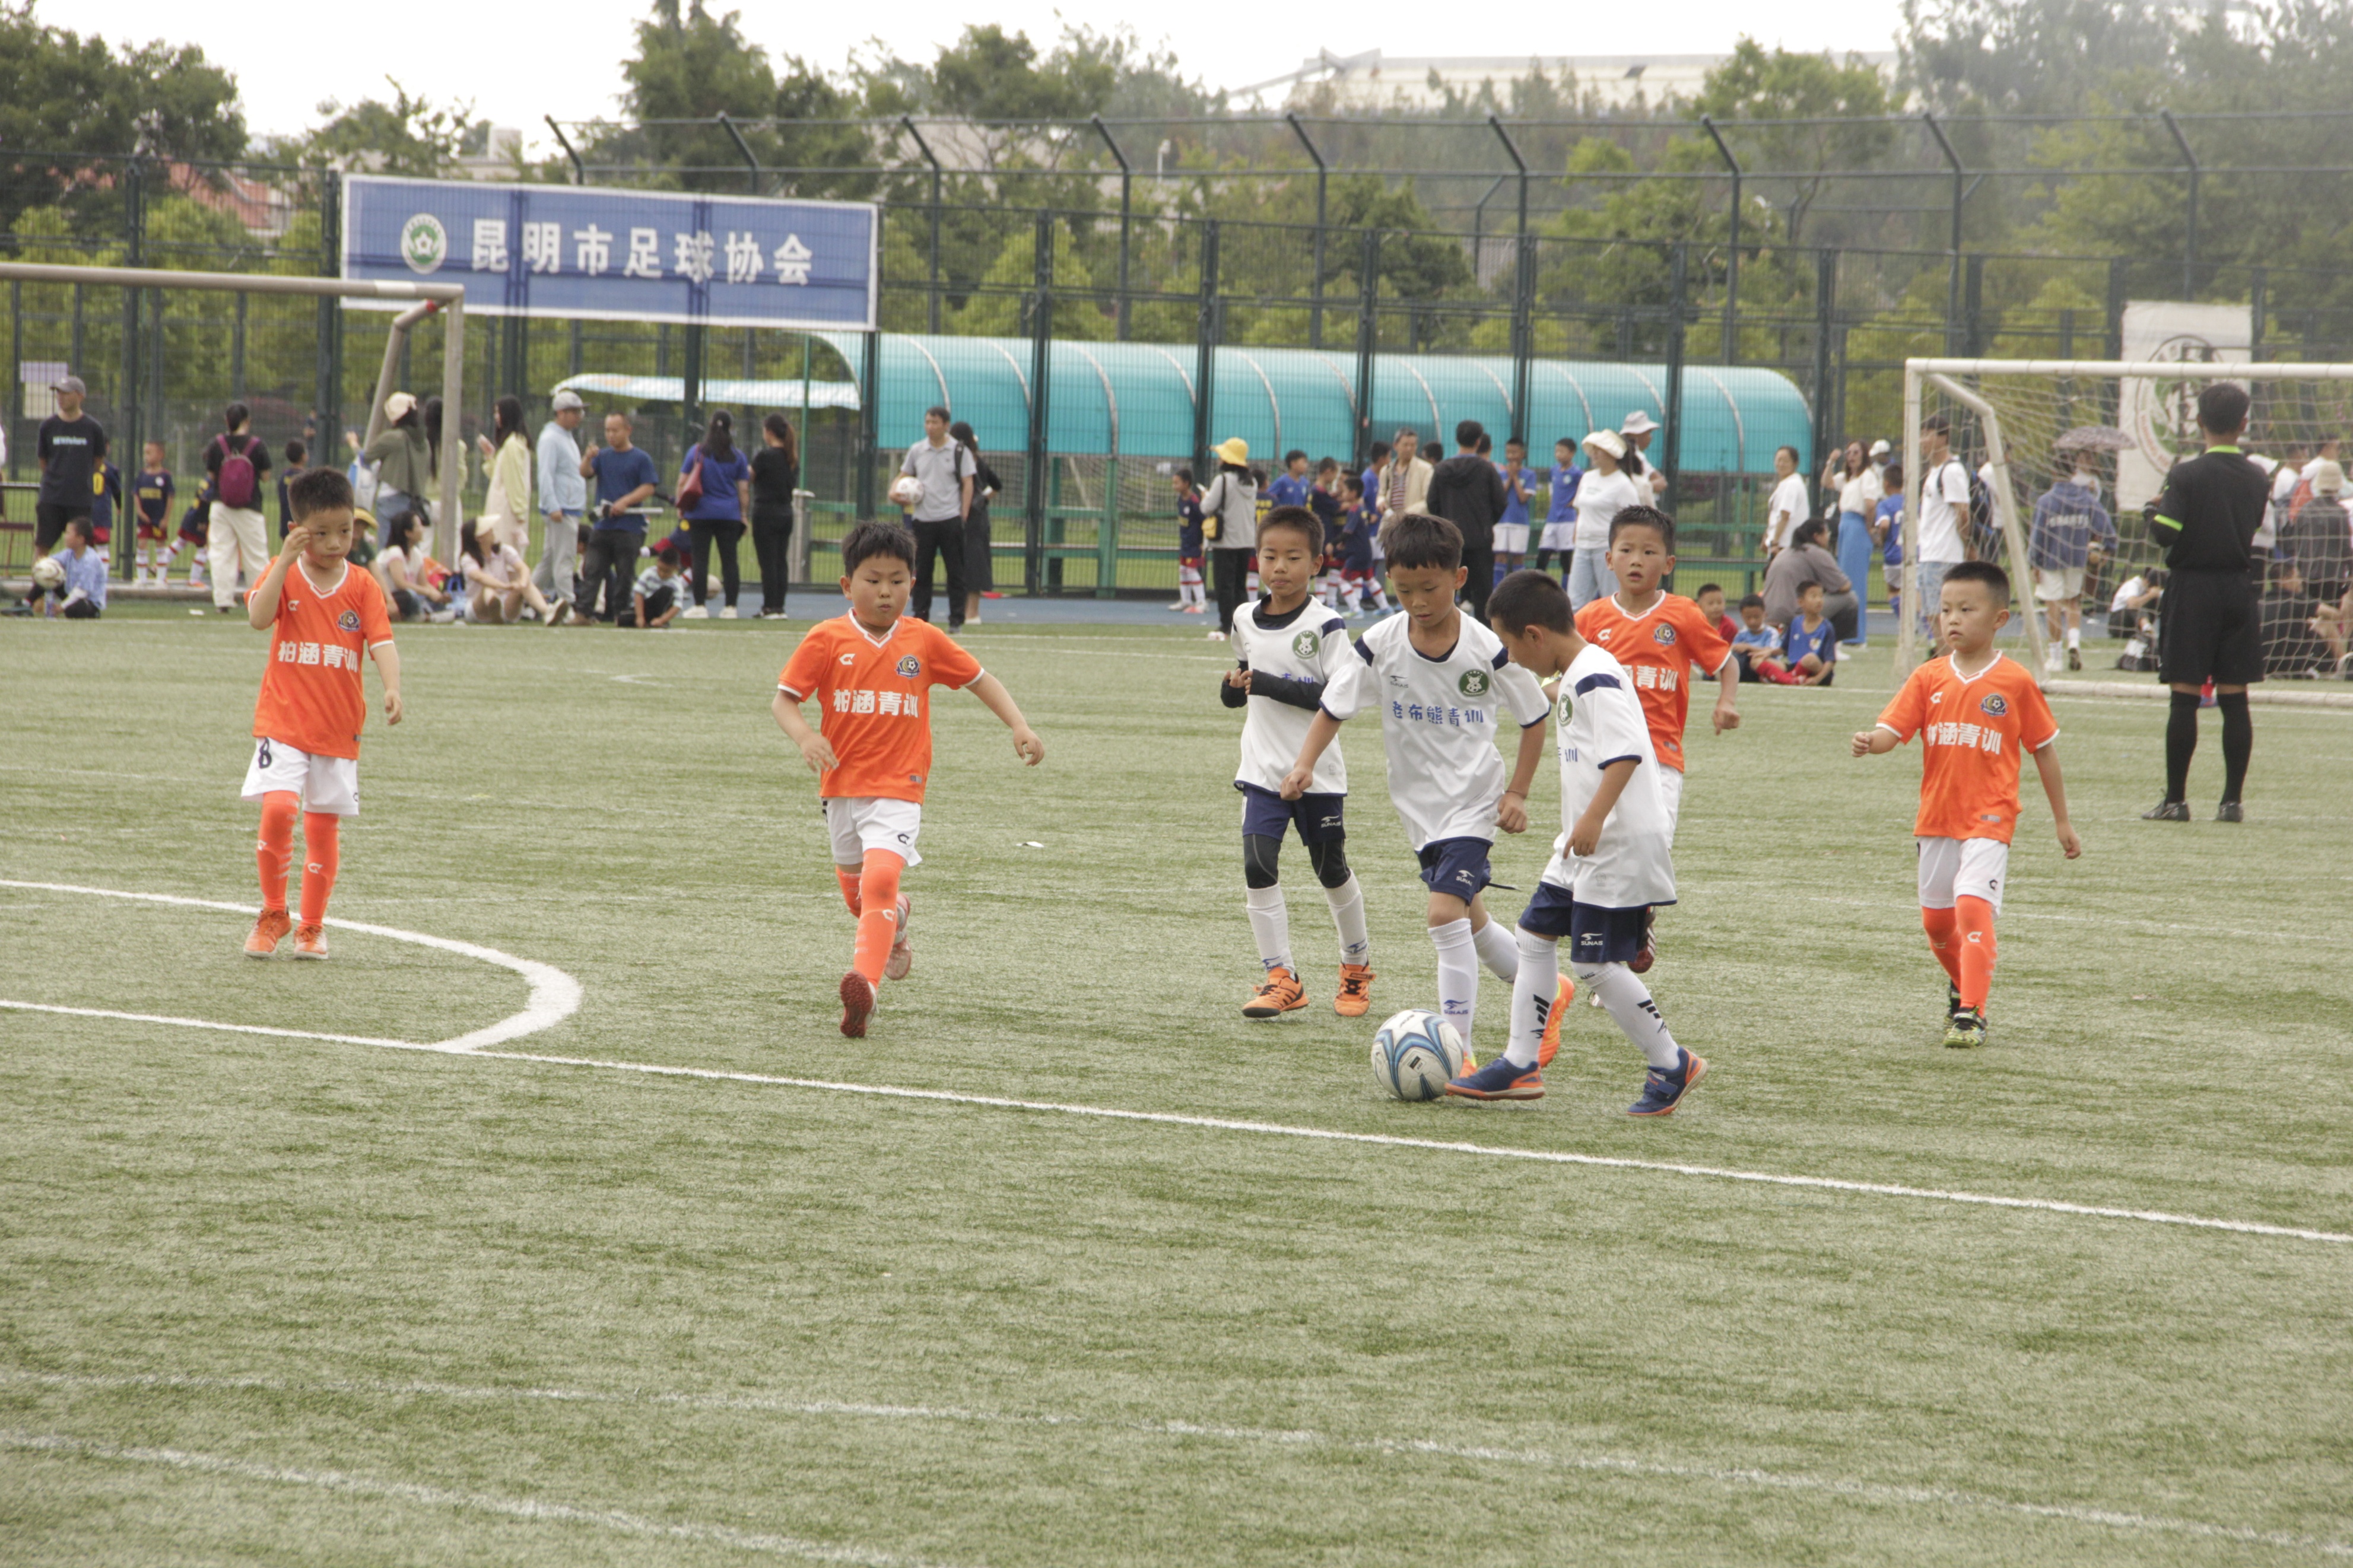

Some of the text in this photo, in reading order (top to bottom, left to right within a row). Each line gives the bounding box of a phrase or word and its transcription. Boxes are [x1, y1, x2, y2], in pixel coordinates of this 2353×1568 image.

[472, 218, 814, 285] 昆明市足球协会
[278, 641, 358, 672] 柏涵青训
[833, 689, 919, 718] 柏涵青训
[259, 737, 272, 768] 8
